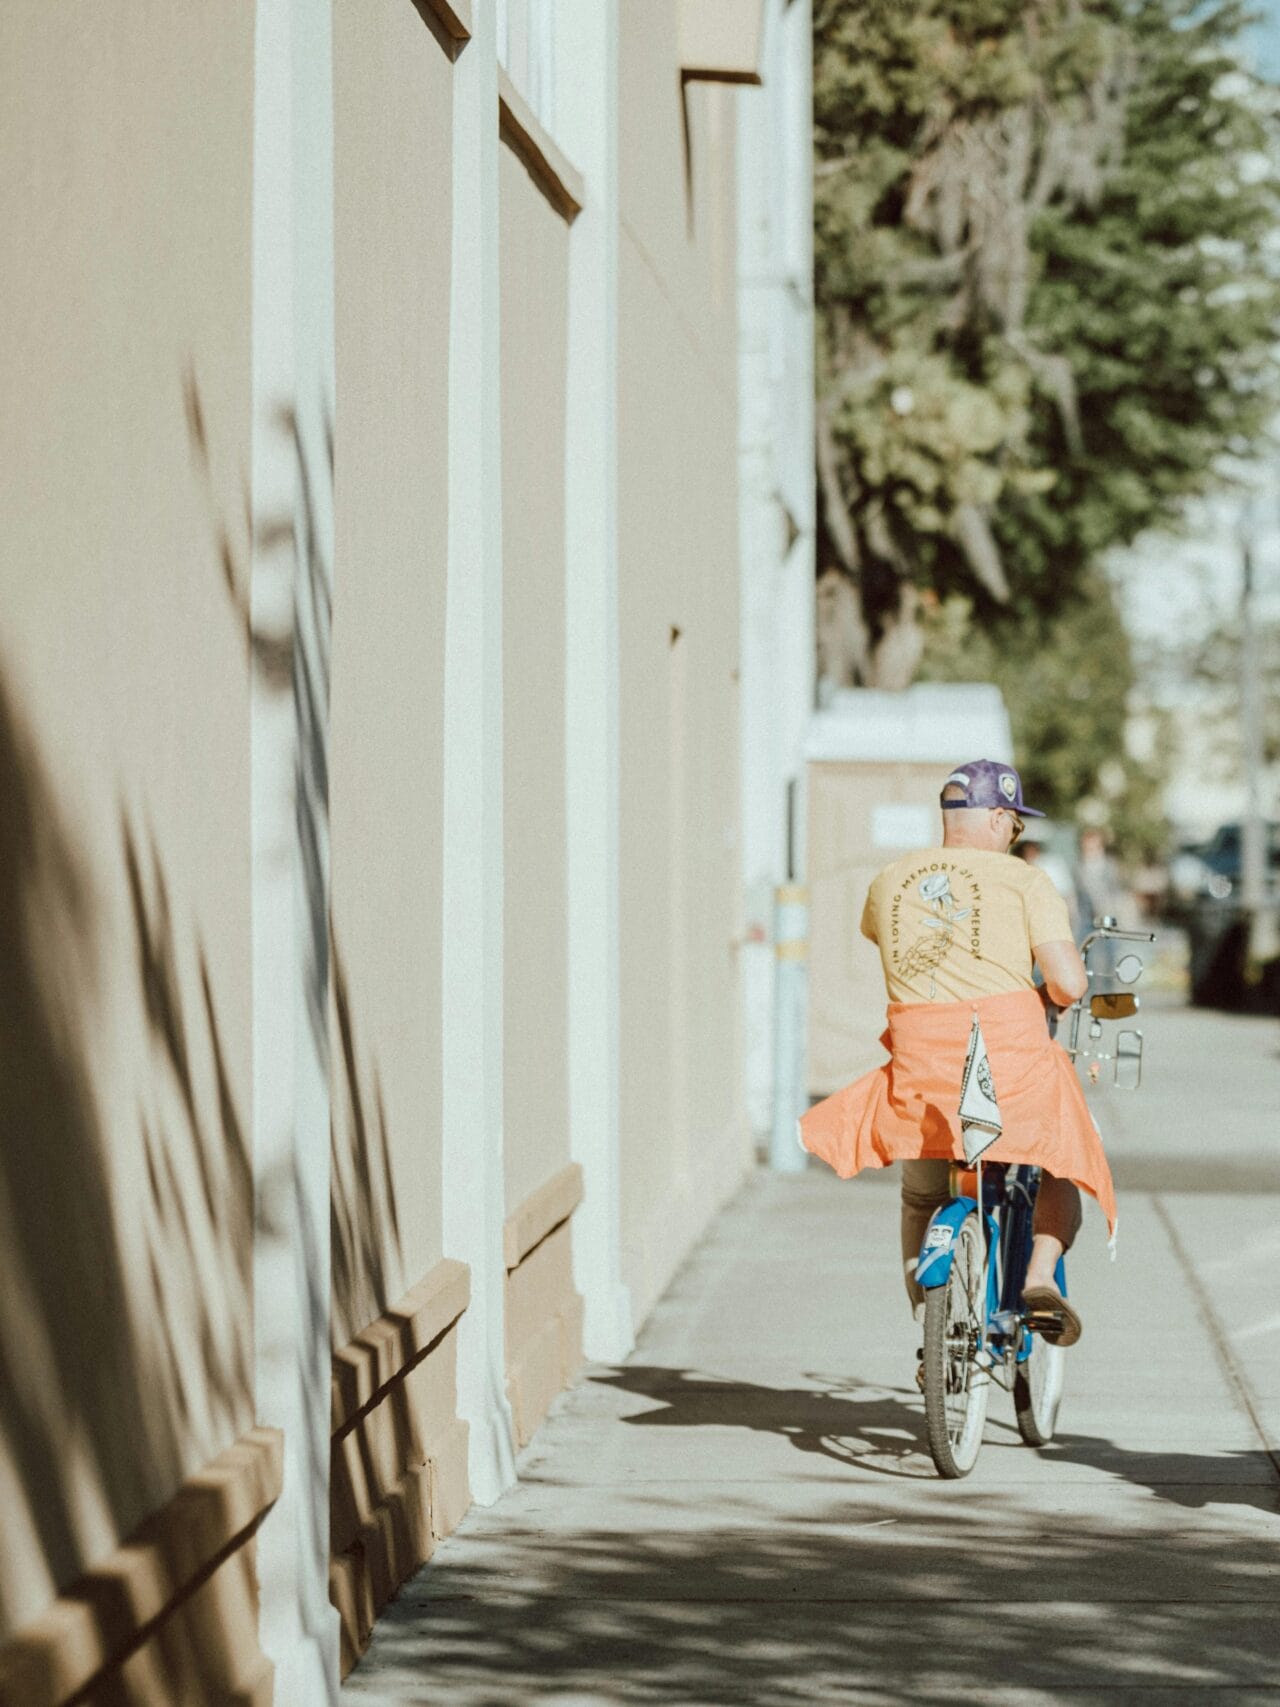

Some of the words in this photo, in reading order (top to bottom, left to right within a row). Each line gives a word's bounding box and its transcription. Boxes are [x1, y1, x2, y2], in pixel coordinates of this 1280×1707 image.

[901, 862, 957, 890] MEMORY
[960, 868, 974, 880] OF
[971, 883, 982, 901] MY
[891, 894, 902, 944] LOVING
[892, 950, 900, 963] IN
